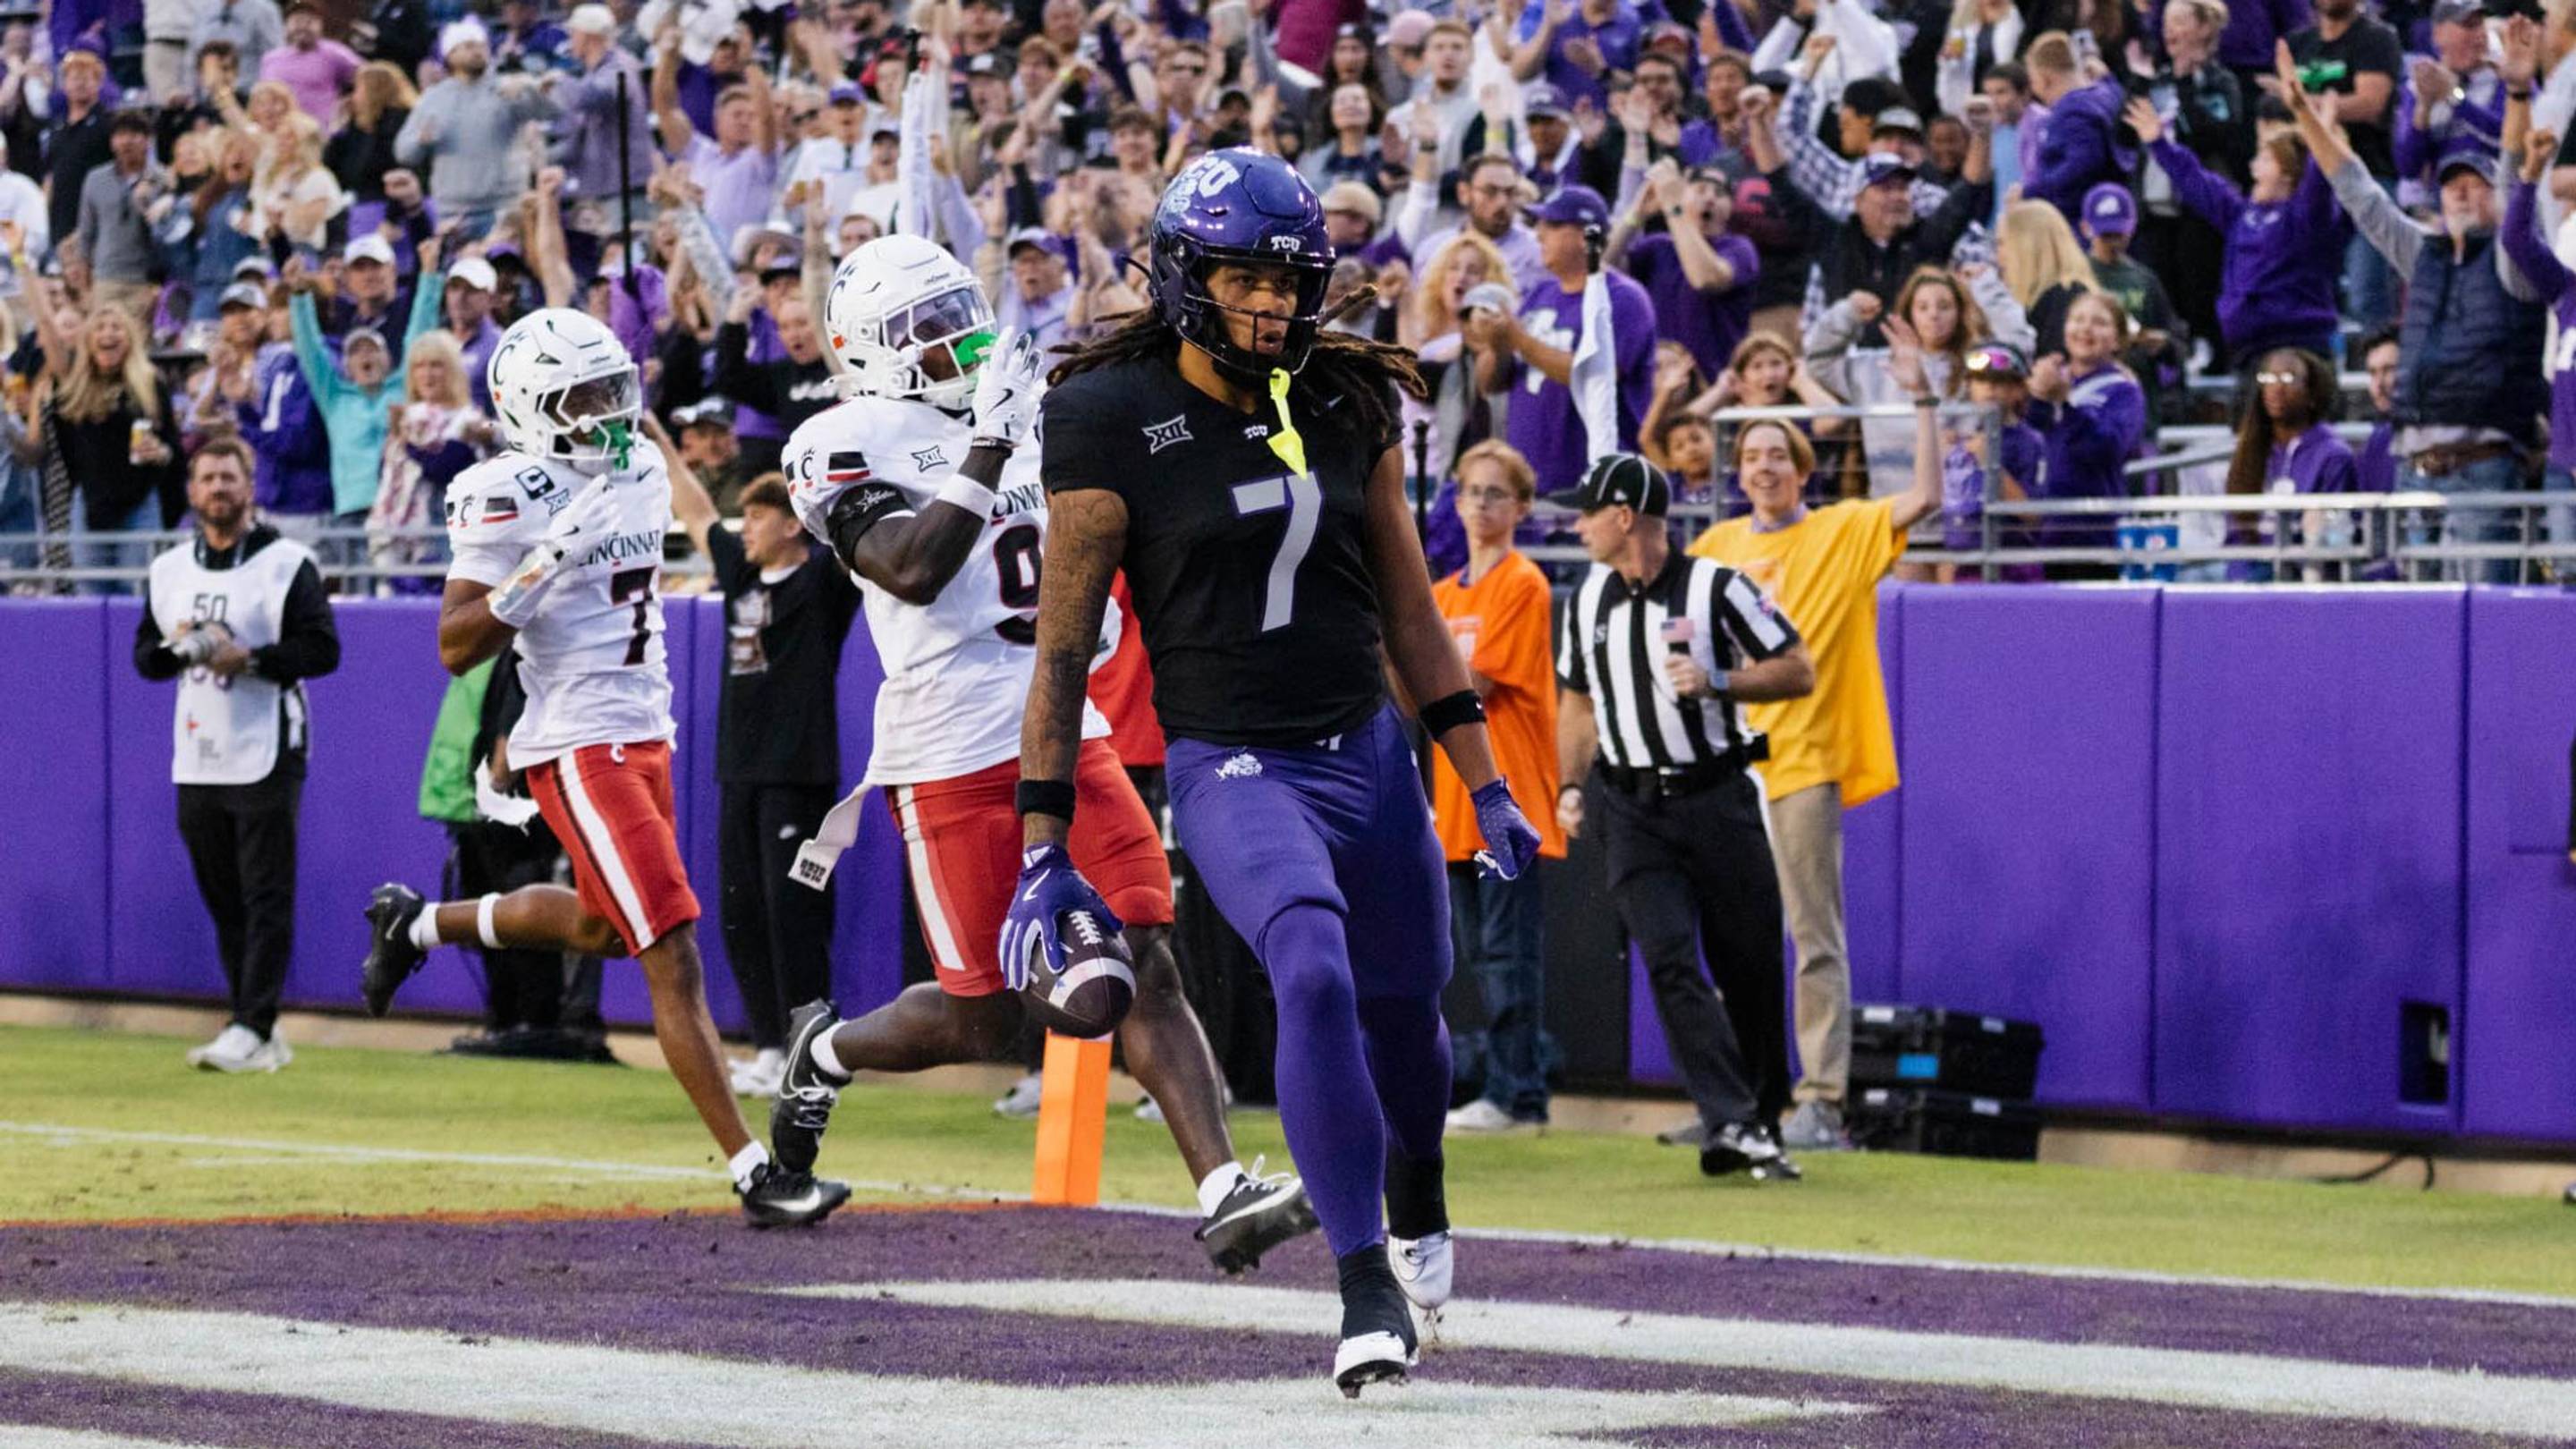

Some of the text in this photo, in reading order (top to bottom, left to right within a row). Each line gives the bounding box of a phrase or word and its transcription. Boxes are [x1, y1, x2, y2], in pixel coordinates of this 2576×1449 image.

[1271, 236, 1300, 251] TCU
[1243, 425, 1268, 439] TCU
[1230, 469, 1323, 632] 7
[611, 564, 656, 666] 7
